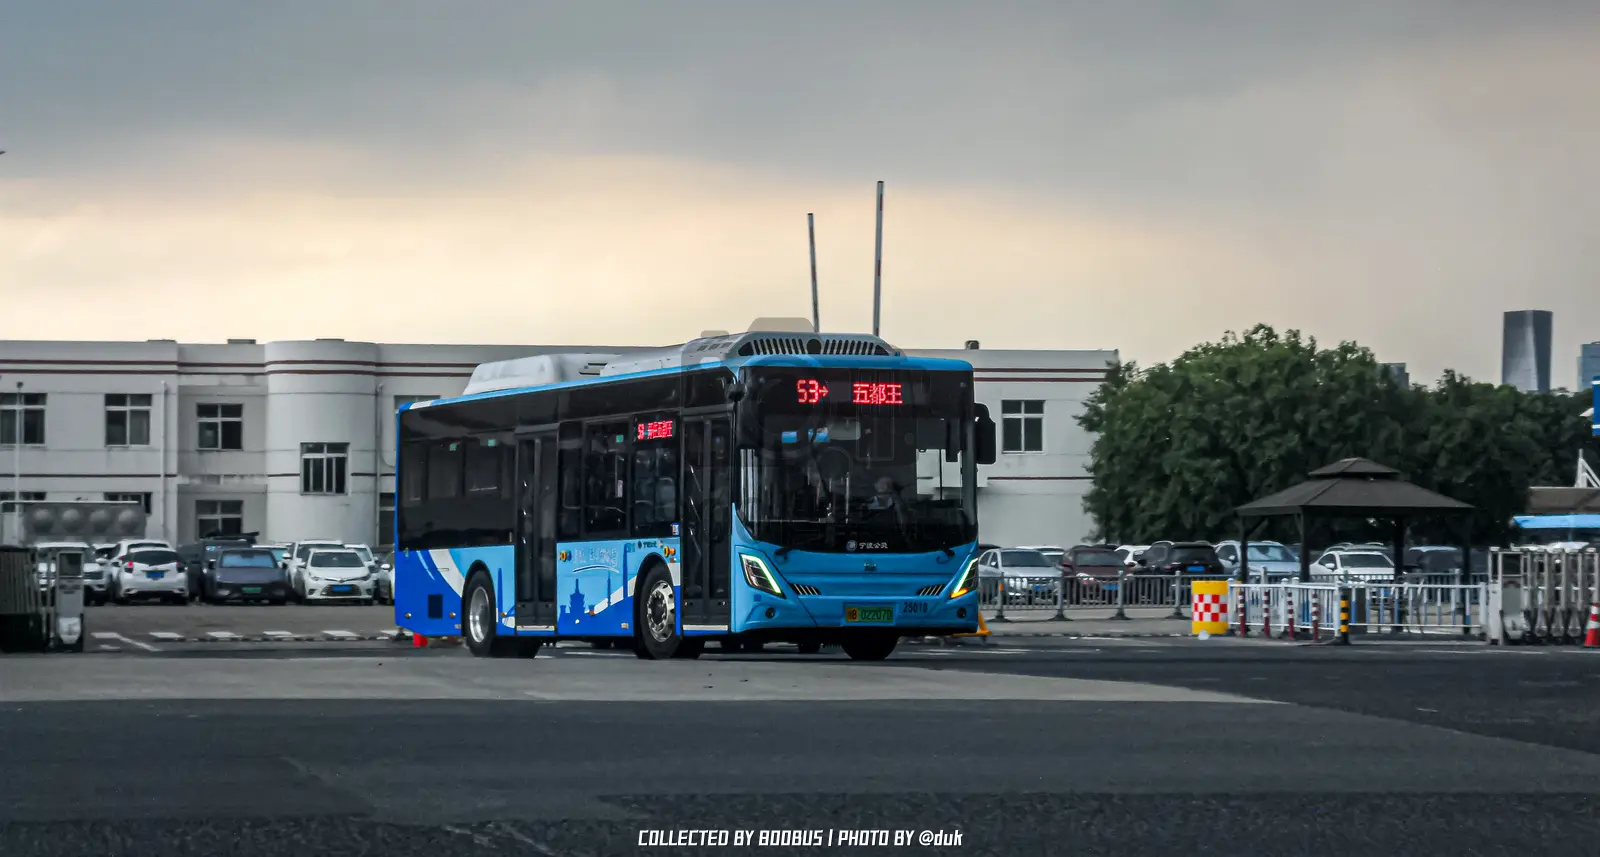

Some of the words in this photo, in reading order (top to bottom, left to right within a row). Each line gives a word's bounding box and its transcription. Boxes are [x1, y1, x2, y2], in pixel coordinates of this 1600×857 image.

[852, 382, 903, 404] 五都王
[903, 601, 928, 613] 25010
